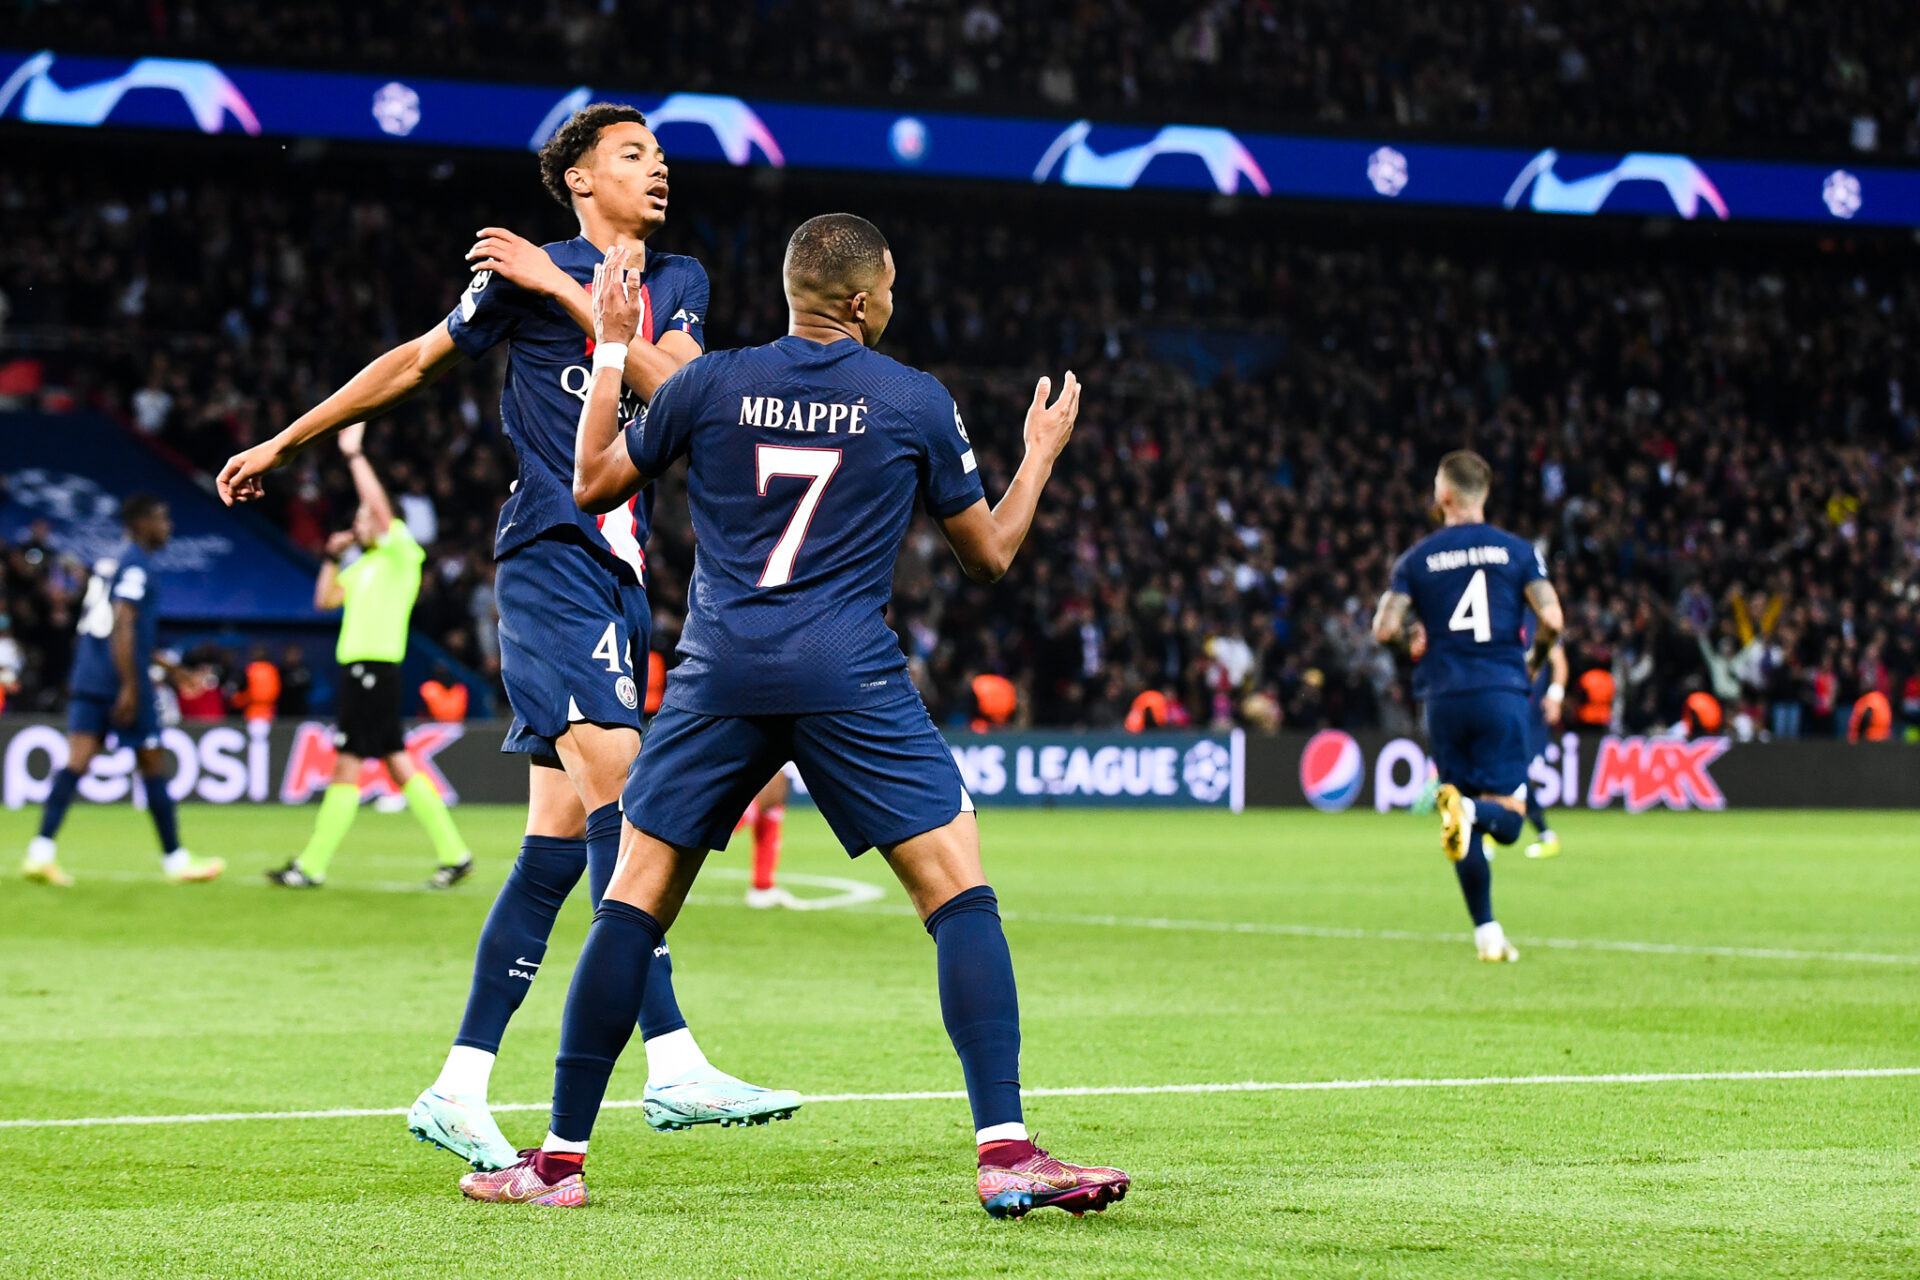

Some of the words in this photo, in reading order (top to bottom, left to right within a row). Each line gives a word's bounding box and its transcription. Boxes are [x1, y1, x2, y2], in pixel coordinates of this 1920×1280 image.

[738, 396, 868, 434] MBAPPÉ
[756, 443, 842, 588] 7
[1448, 568, 1491, 643] 4
[1015, 745, 1178, 796] LEAGUE
[1375, 732, 1579, 814] psi
[1588, 735, 1732, 814] MAX
